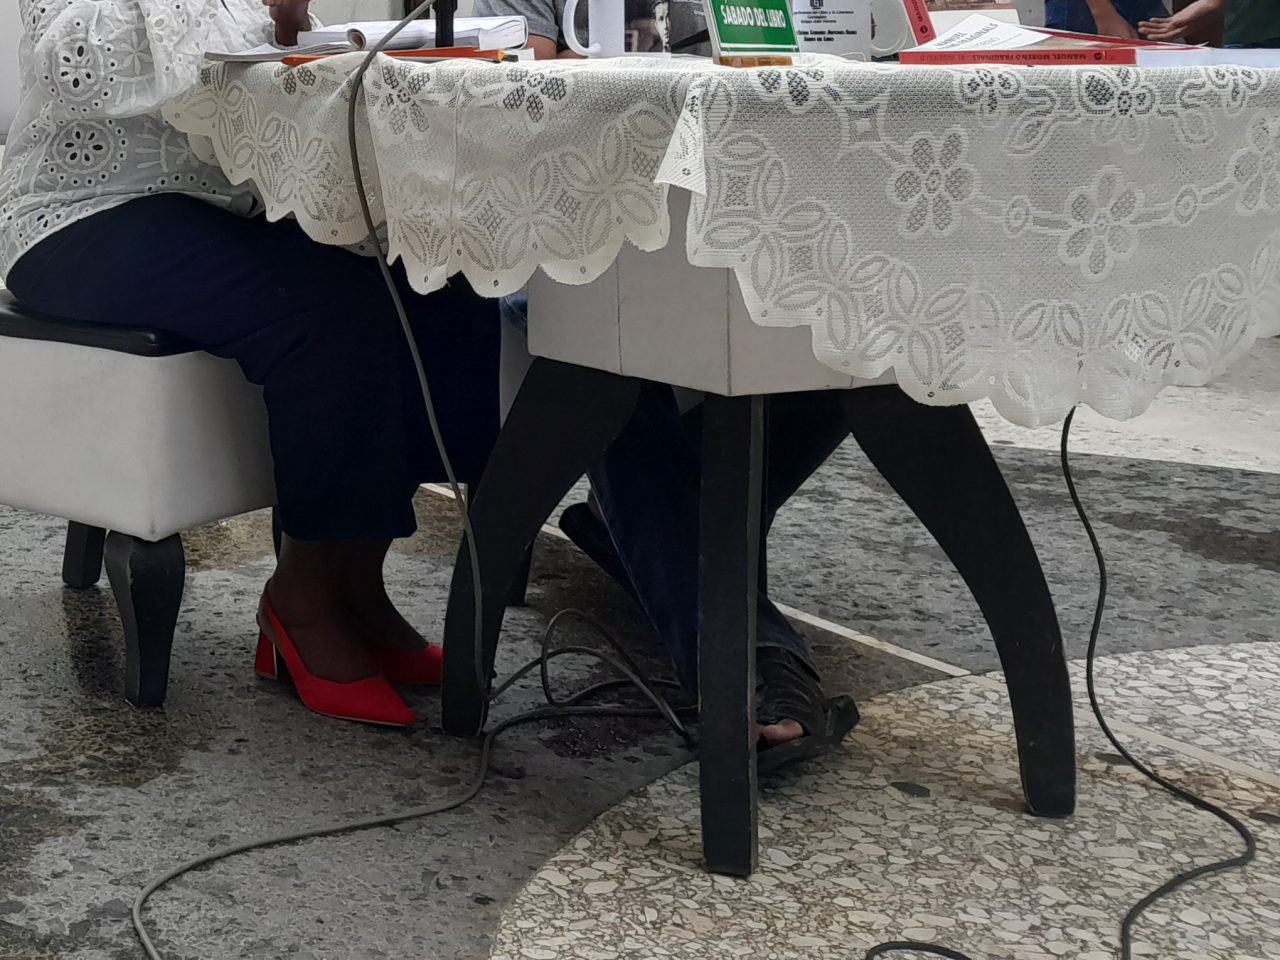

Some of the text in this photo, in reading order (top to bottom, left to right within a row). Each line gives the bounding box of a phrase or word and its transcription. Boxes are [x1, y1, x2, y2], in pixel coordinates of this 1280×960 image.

[753, 7, 769, 27] DEL
[765, 8, 787, 29] LIBRO
[972, 53, 1013, 61] FRAGINALS
[1014, 53, 1051, 61] MORENO
[1052, 53, 1087, 61] MANUEL
